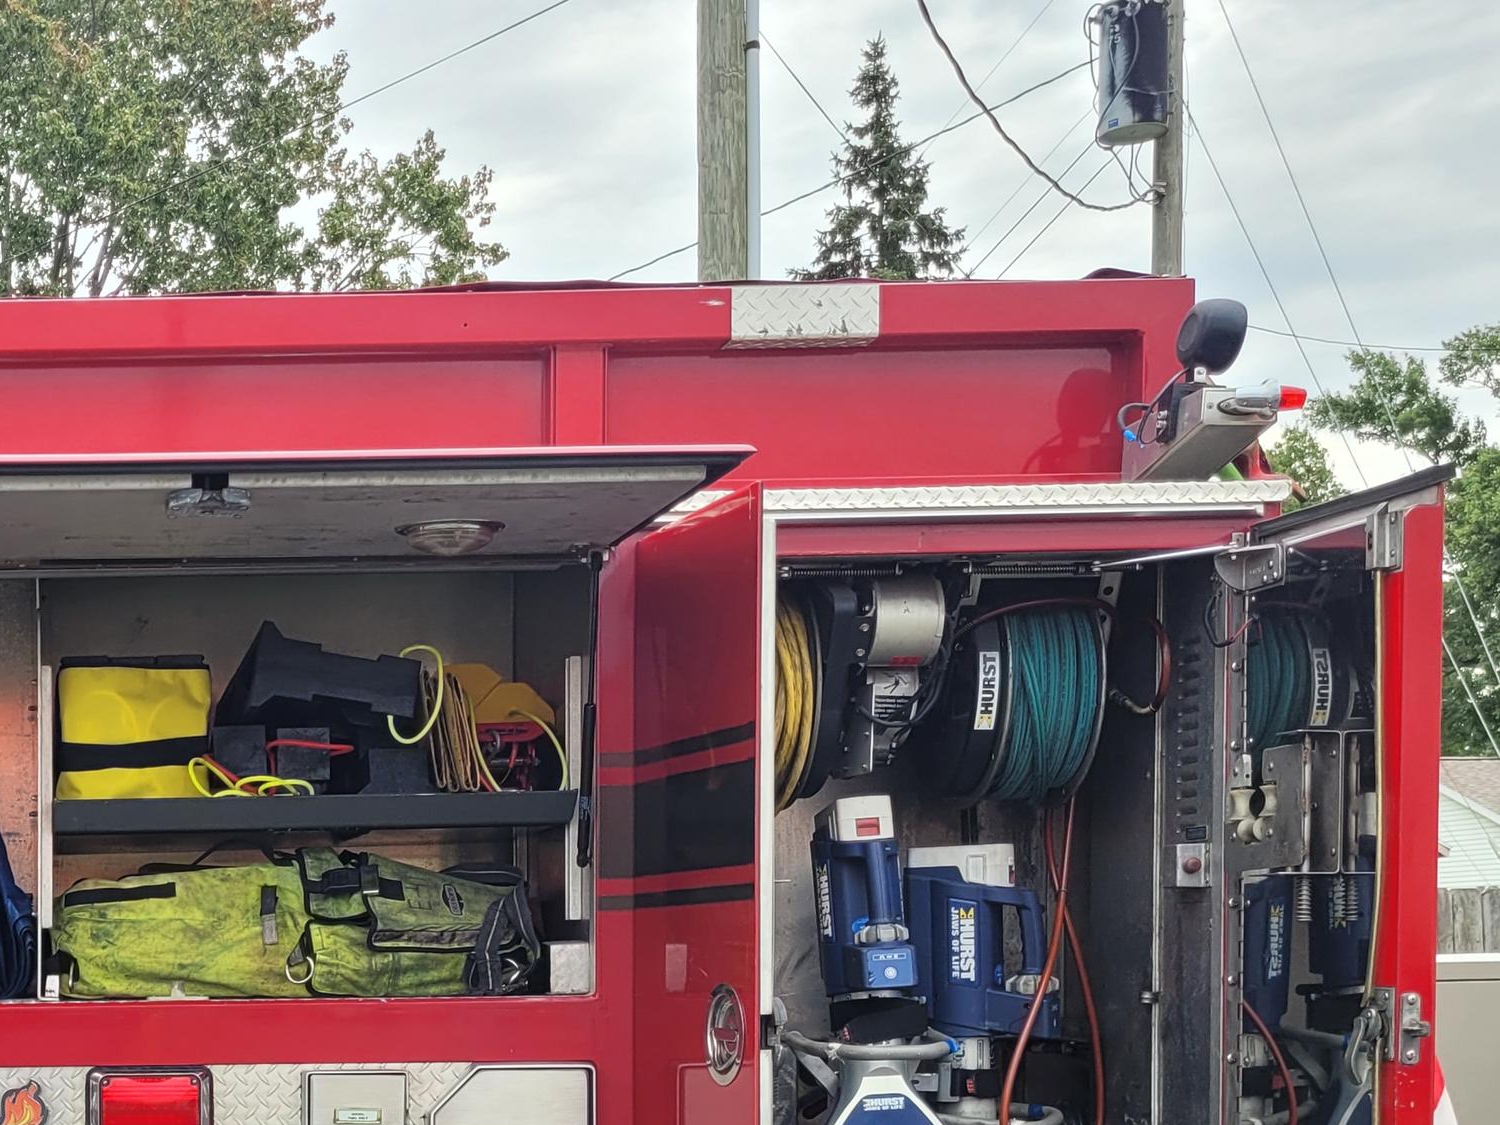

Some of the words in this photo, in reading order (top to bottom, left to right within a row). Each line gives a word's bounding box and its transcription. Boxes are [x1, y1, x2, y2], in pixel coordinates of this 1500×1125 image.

[980, 653, 997, 715] HURST
[819, 873, 833, 938] HURST
[951, 907, 960, 937] JAWS
[951, 941, 960, 952] OF
[960, 918, 975, 982] HURST
[951, 956, 960, 979] LIFE
[871, 1097, 904, 1106] HURST
